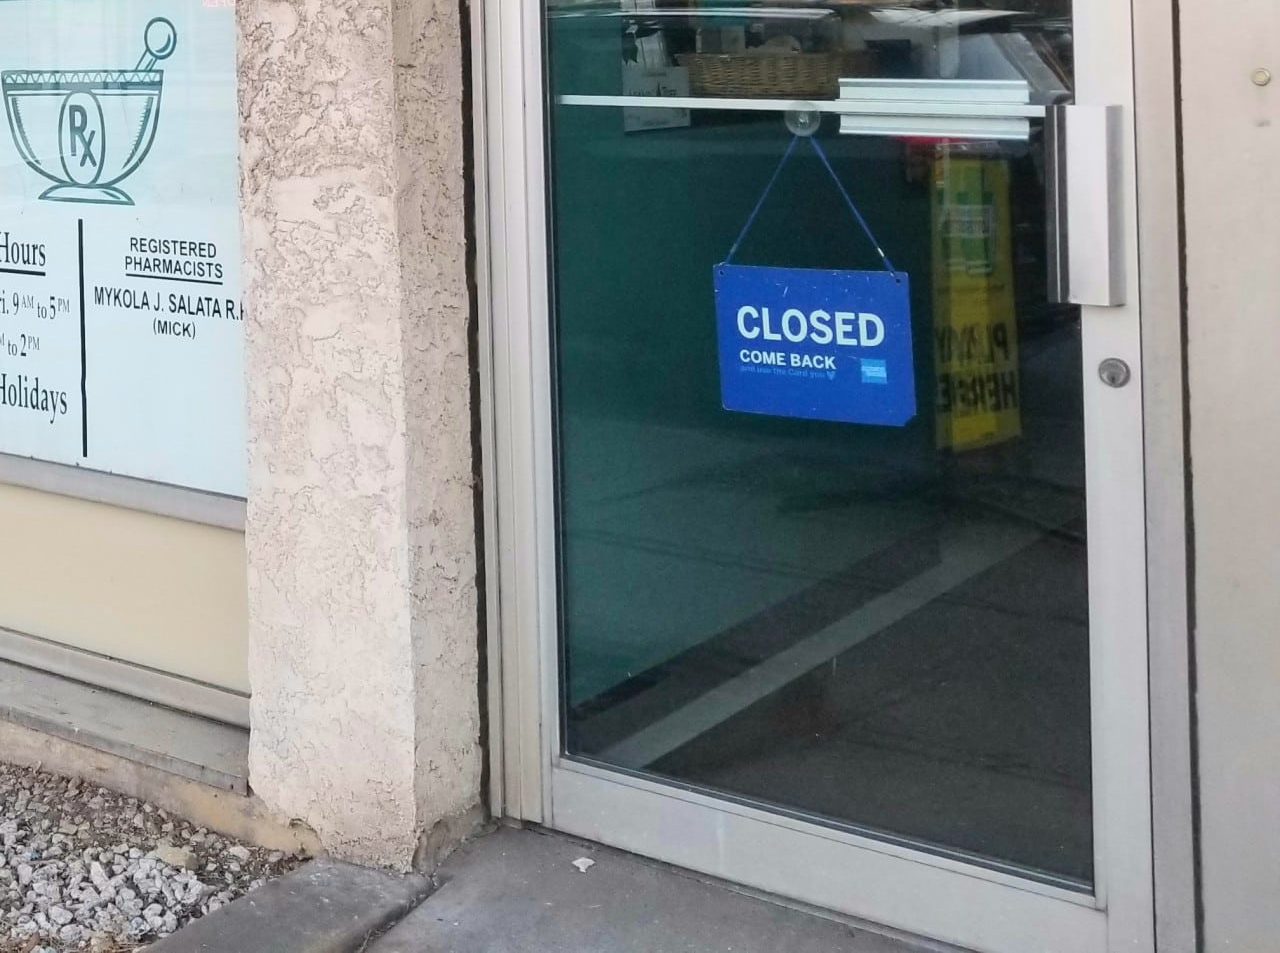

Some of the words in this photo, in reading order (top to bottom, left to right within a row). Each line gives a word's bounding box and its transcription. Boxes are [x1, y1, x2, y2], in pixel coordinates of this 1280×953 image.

[130, 237, 217, 259] REGISTERED
[125, 256, 223, 279] PHARMACISTS
[37, 301, 47, 319] to
[94, 285, 150, 311] MYKOLA
[154, 292, 164, 312] J.
[169, 293, 222, 319] SALATA
[153, 317, 196, 340] (MICK)
[737, 305, 885, 347] CLOSED
[7, 340, 17, 356] to
[740, 349, 786, 366] COME
[790, 353, 836, 370] BACK
